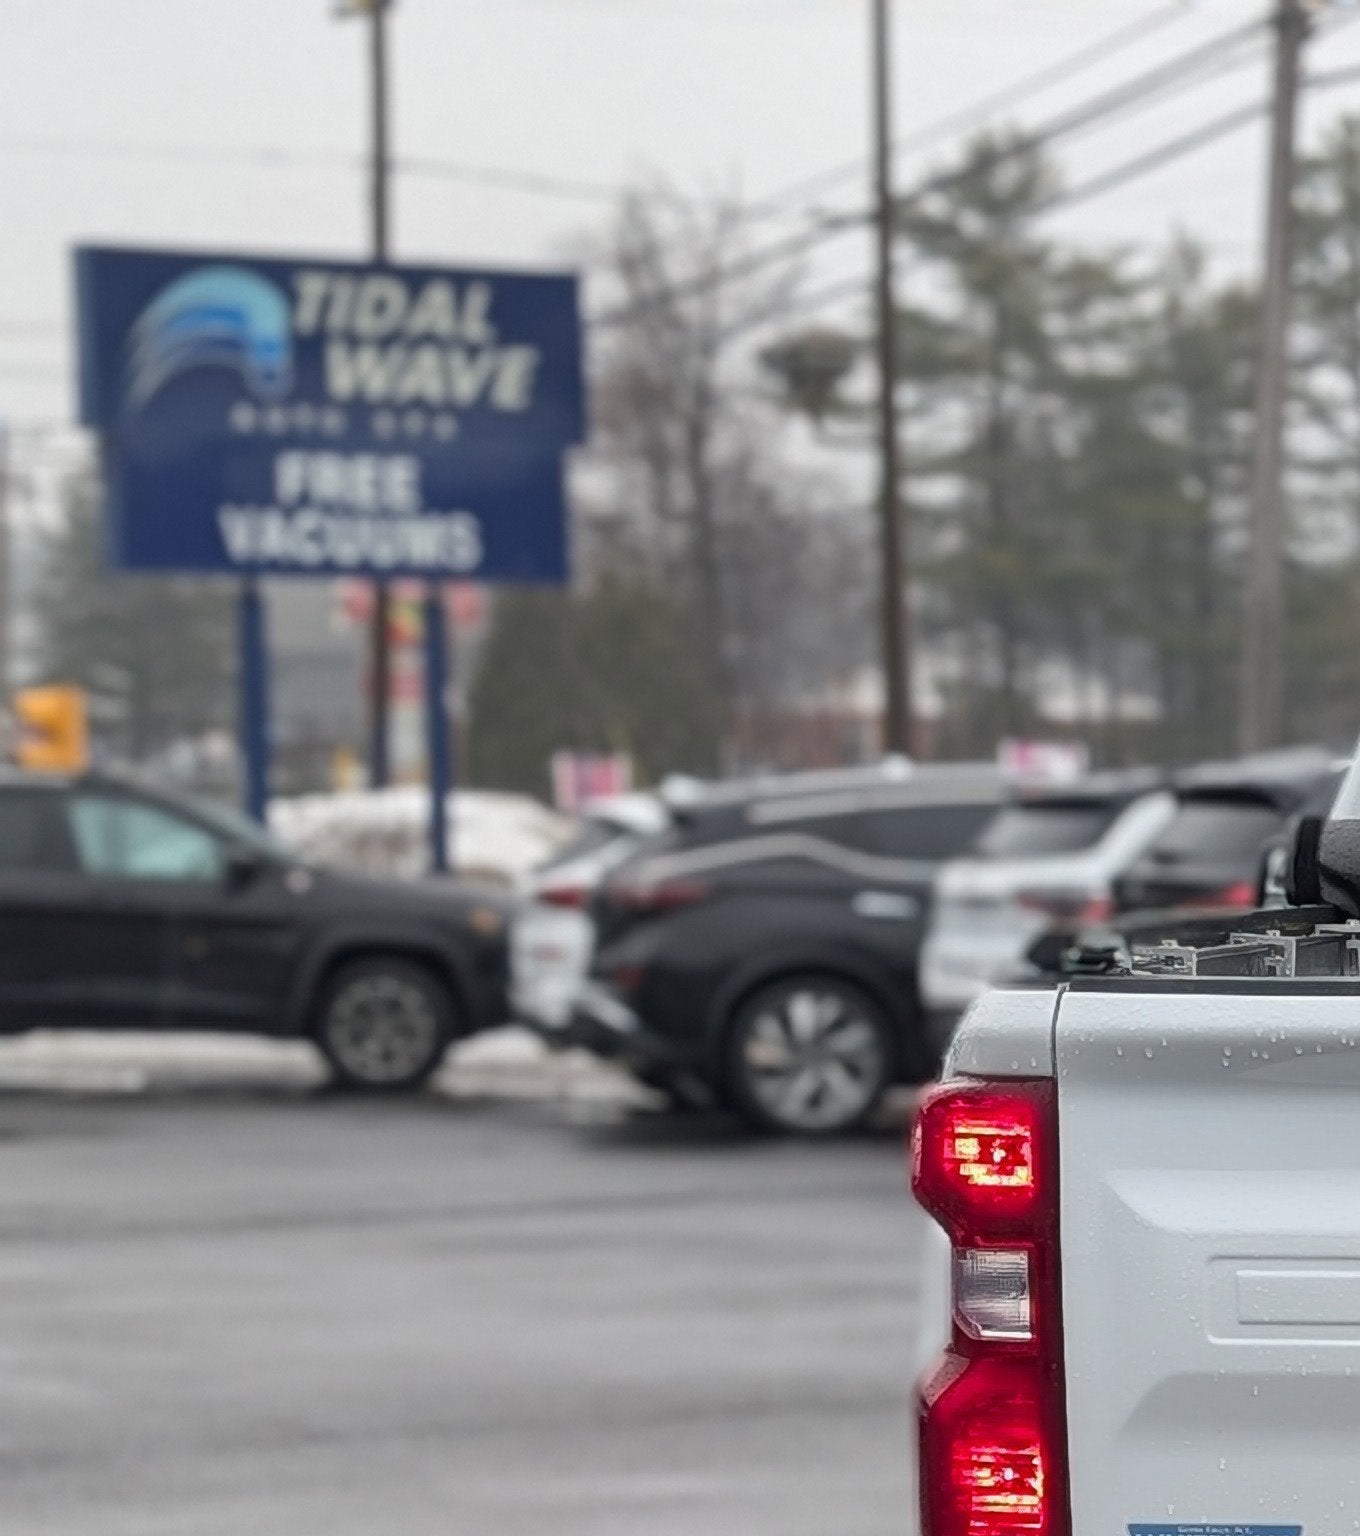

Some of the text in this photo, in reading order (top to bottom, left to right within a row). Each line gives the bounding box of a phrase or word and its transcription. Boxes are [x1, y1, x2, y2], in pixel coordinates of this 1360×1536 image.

[294, 271, 497, 346] TIDAL
[324, 340, 540, 412] WAVE
[275, 450, 421, 514] FREE
[218, 503, 481, 572] VACUUMS
